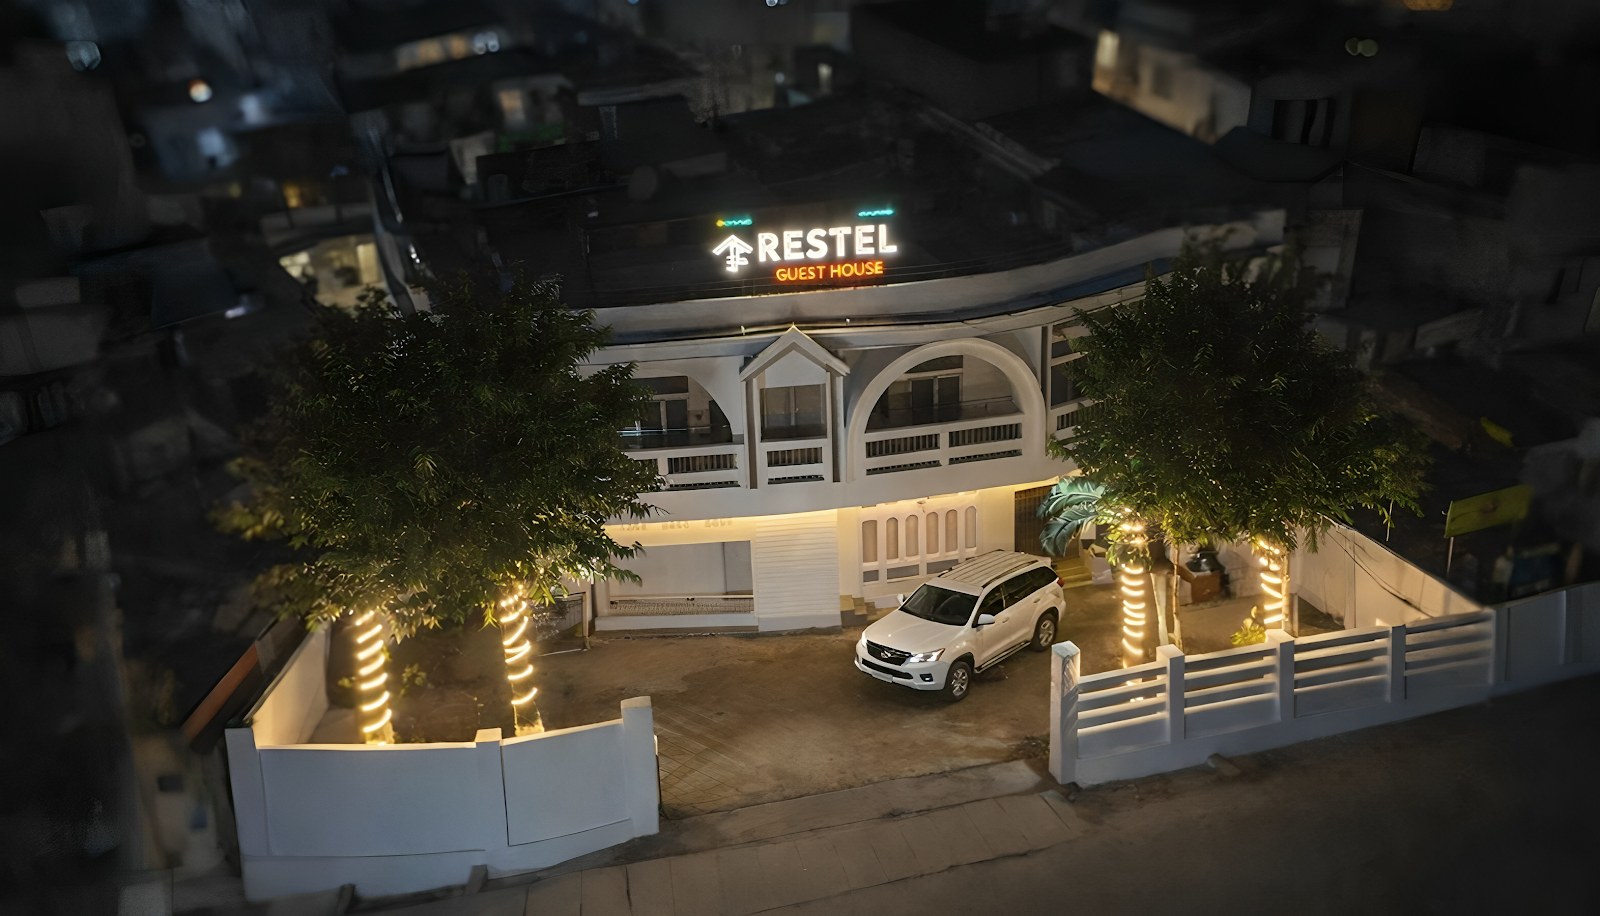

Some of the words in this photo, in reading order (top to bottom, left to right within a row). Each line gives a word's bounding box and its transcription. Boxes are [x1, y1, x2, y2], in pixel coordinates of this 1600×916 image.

[758, 224, 898, 262] RESTEL
[776, 265, 826, 281] GUEST
[830, 261, 884, 278] HOUSE
